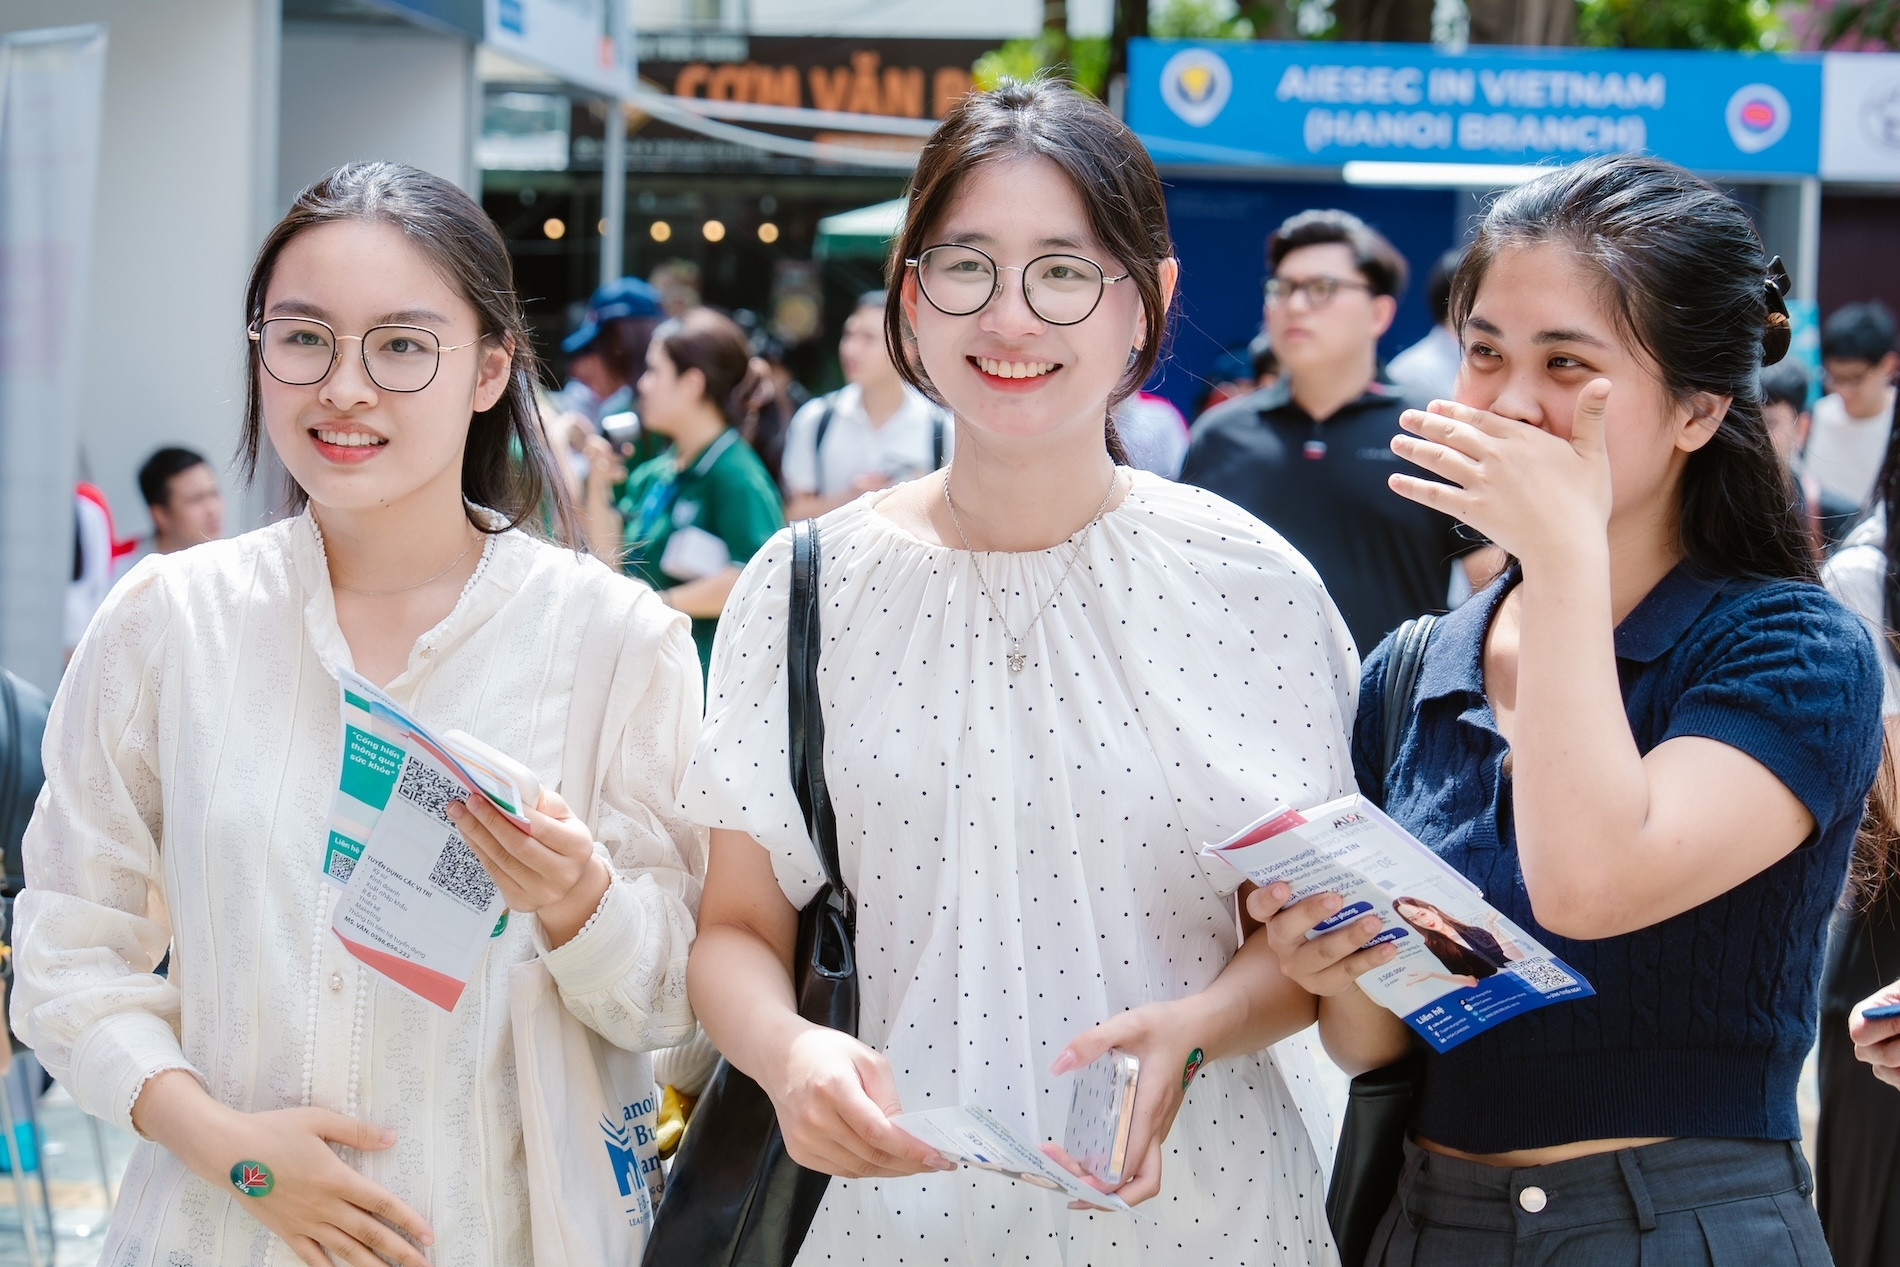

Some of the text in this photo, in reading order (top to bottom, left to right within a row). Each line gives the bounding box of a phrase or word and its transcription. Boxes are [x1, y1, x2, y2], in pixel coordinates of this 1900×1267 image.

[1278, 65, 1666, 109] AIESEC IN VIETNAM
[1305, 110, 1646, 153] (HANOI BRANCH)
[378, 756, 395, 767] qua
[1333, 812, 1363, 829] MISA
[334, 837, 350, 849] Liên
[1347, 843, 1360, 853] TIN
[366, 881, 379, 893] Xuất
[369, 874, 401, 897] Kinh doanh
[386, 866, 403, 881] DỤNG
[403, 876, 416, 889] CÁC
[344, 916, 355, 926] MS.
[348, 908, 366, 924] Thông
[375, 922, 386, 934] liên
[1416, 1009, 1434, 1025] Liên
[1433, 1005, 1446, 1019] hệ
[623, 1091, 655, 1121] anoi
